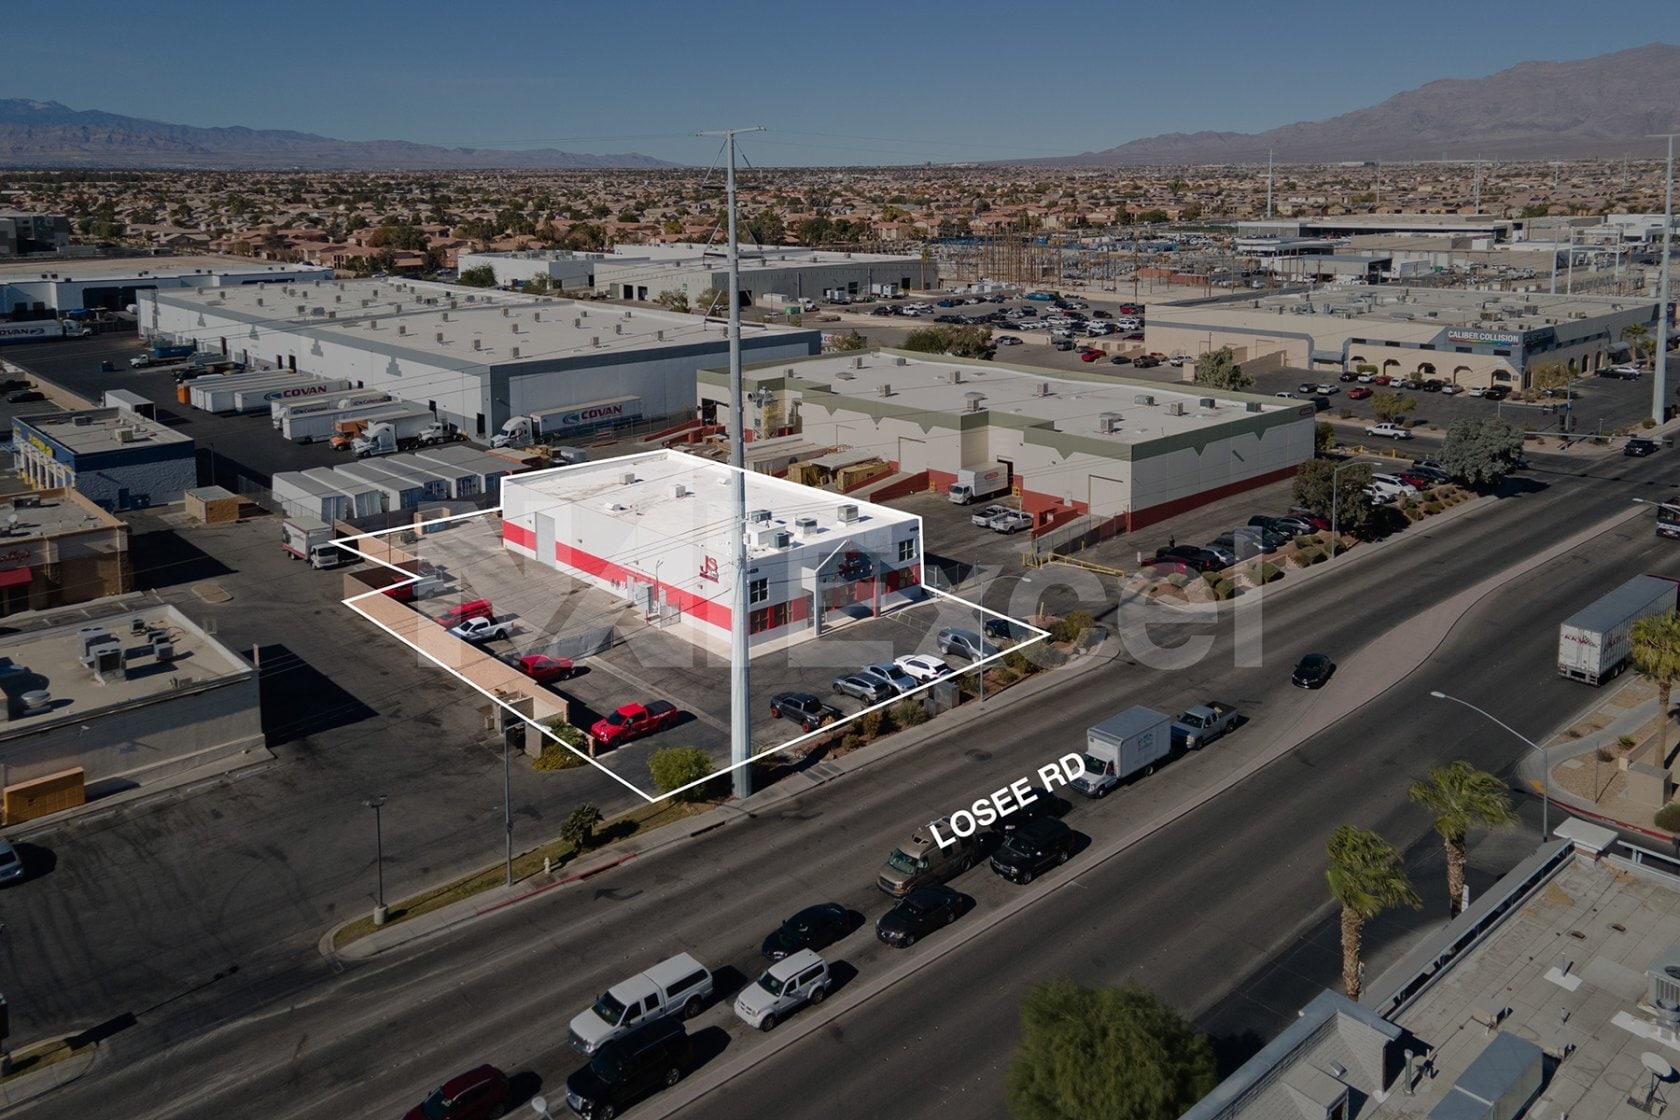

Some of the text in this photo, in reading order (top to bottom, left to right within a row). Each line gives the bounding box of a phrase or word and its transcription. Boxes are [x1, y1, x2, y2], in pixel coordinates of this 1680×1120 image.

[1448, 330, 1479, 340] CALIBER
[1480, 332, 1519, 343] COLLISION
[283, 385, 327, 398] COVAN
[581, 404, 623, 420] COVAN
